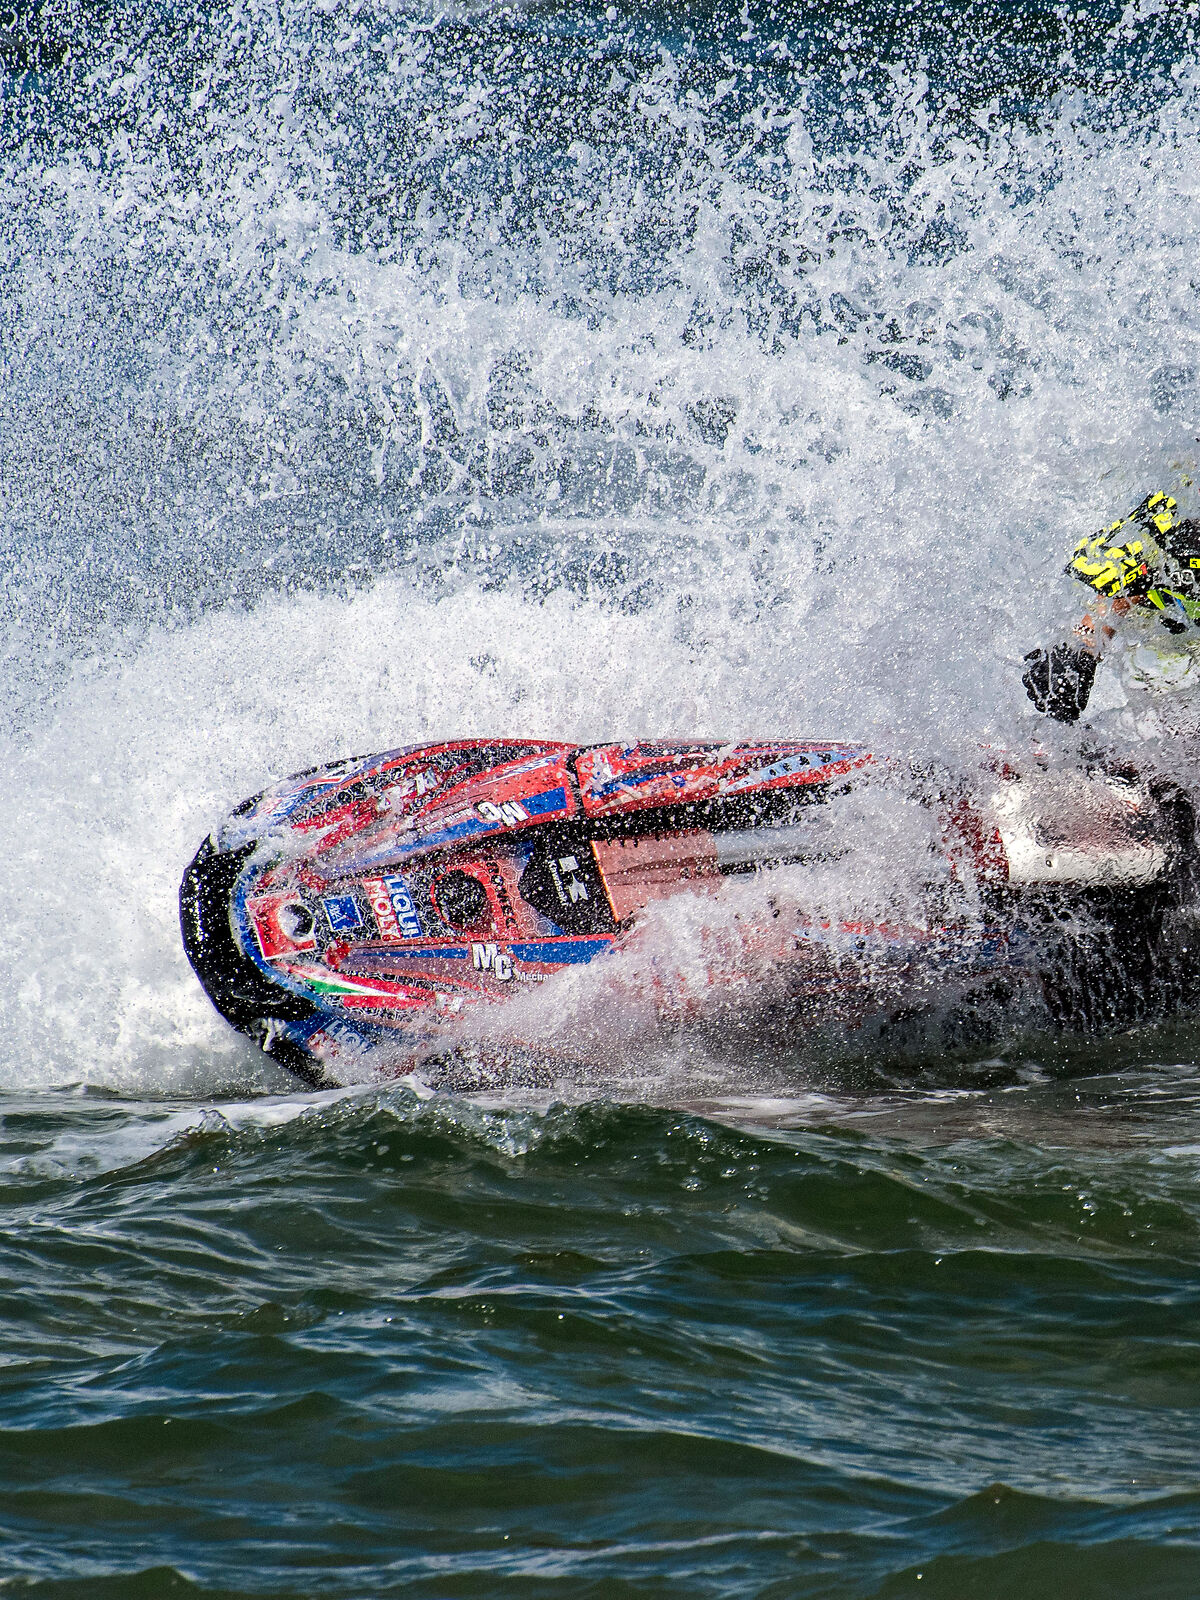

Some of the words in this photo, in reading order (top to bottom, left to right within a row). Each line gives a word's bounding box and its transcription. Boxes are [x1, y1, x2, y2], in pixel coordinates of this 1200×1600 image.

[477, 800, 529, 827] MC
[548, 860, 569, 906] Kawasaki
[364, 880, 401, 940] MOLY
[384, 876, 421, 938] LIQUI
[472, 943, 513, 980] MC
